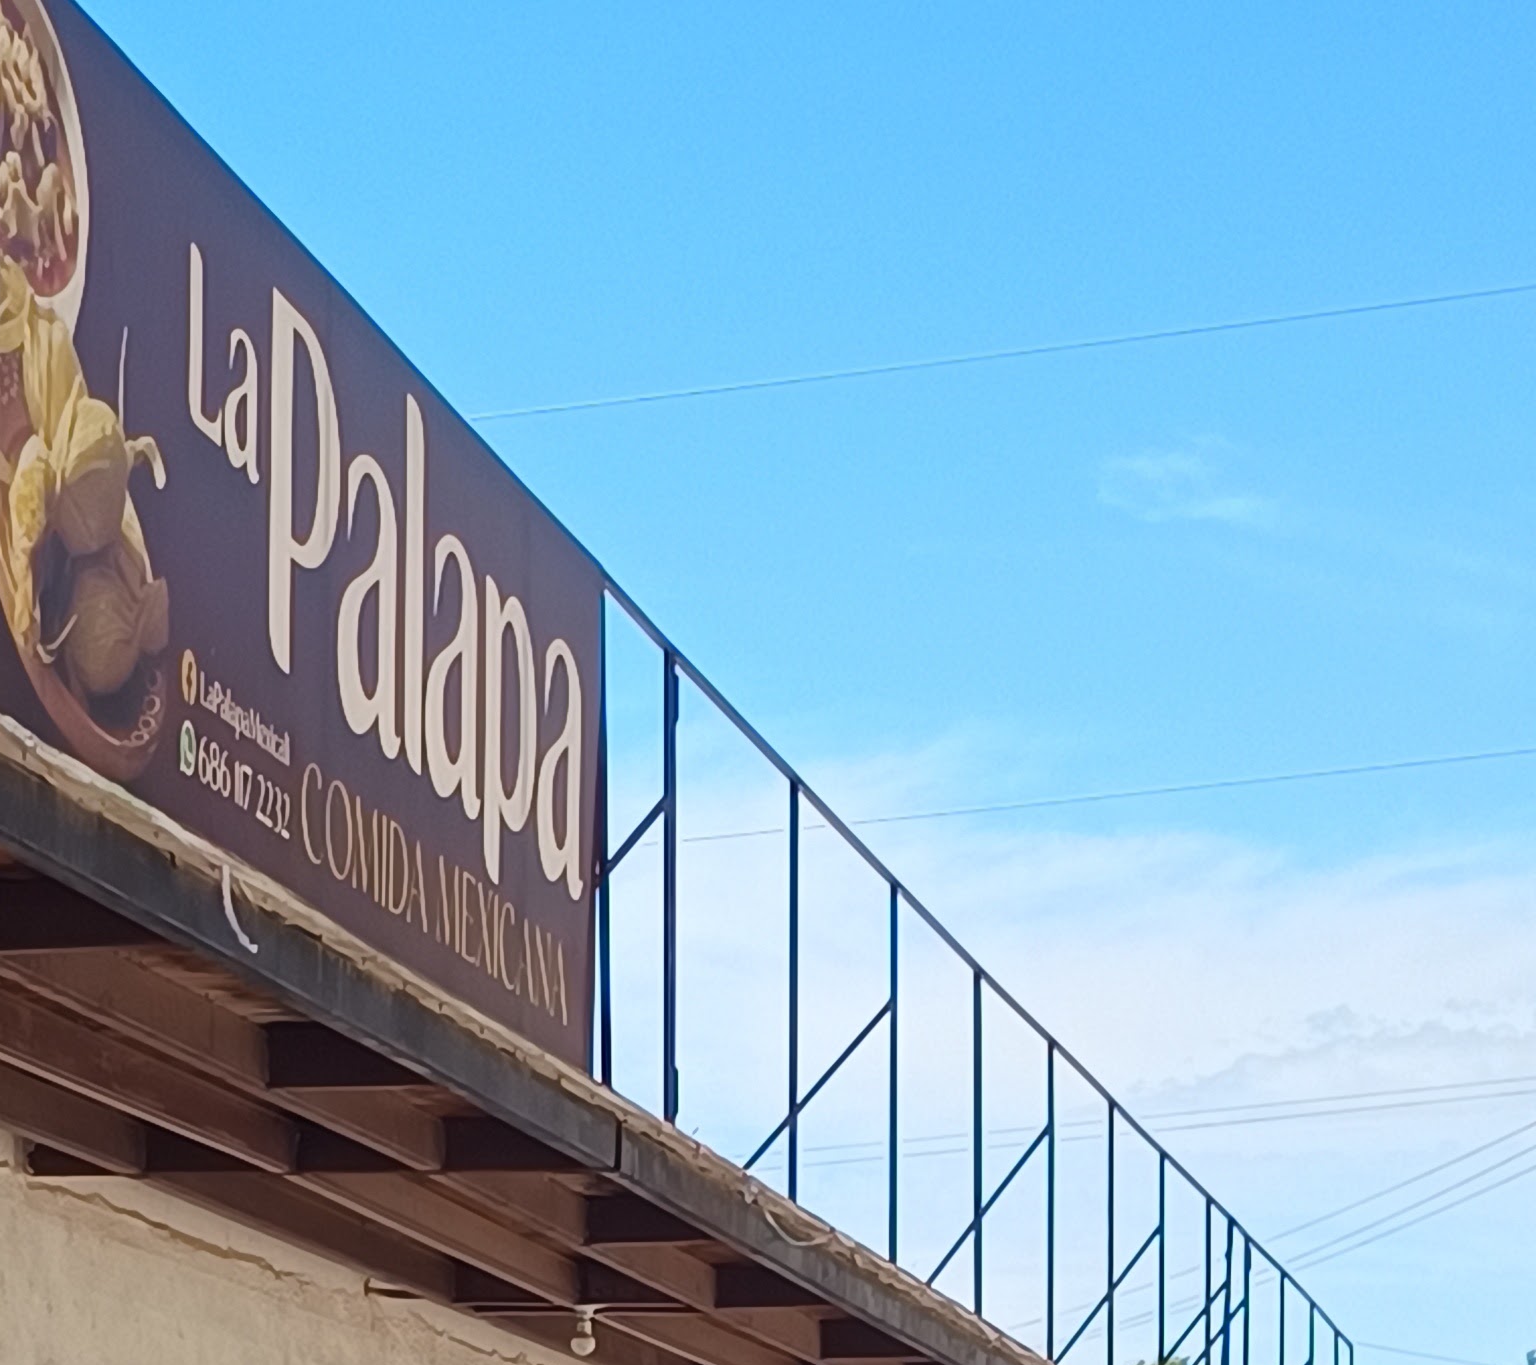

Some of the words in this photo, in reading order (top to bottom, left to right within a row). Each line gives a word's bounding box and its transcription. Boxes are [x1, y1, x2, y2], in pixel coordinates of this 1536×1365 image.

[188, 242, 260, 485] La
[268, 286, 584, 901] Palapa
[198, 735, 232, 798] 686
[233, 760, 254, 811] 117
[301, 762, 429, 934] COMIDA
[434, 854, 568, 1026] MEXICANA
